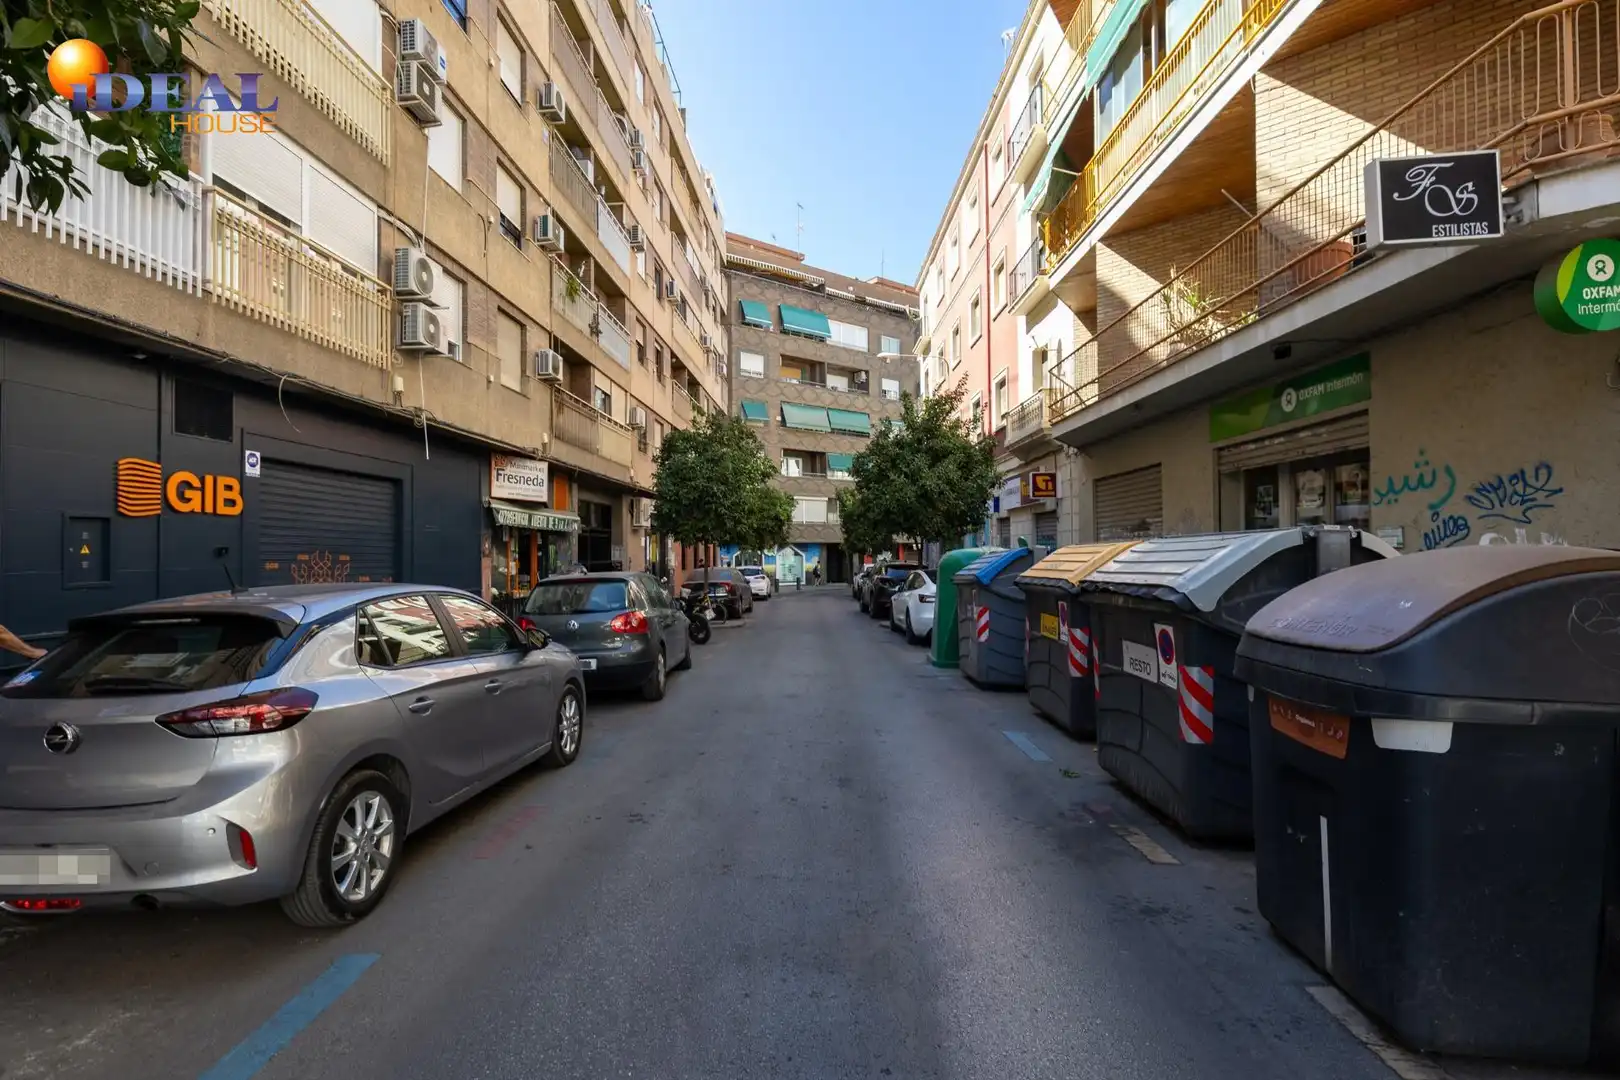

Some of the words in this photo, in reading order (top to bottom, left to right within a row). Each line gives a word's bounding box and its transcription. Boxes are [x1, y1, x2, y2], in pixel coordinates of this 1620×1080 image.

[1432, 221, 1489, 238] ESTILISTAS
[1582, 285, 1620, 300] OXFAM
[1578, 298, 1620, 315] Intermó
[1299, 383, 1325, 400] OXFAM
[496, 468, 545, 488] Fresneda
[166, 470, 244, 516] GIB
[1129, 657, 1152, 676] RESTO
